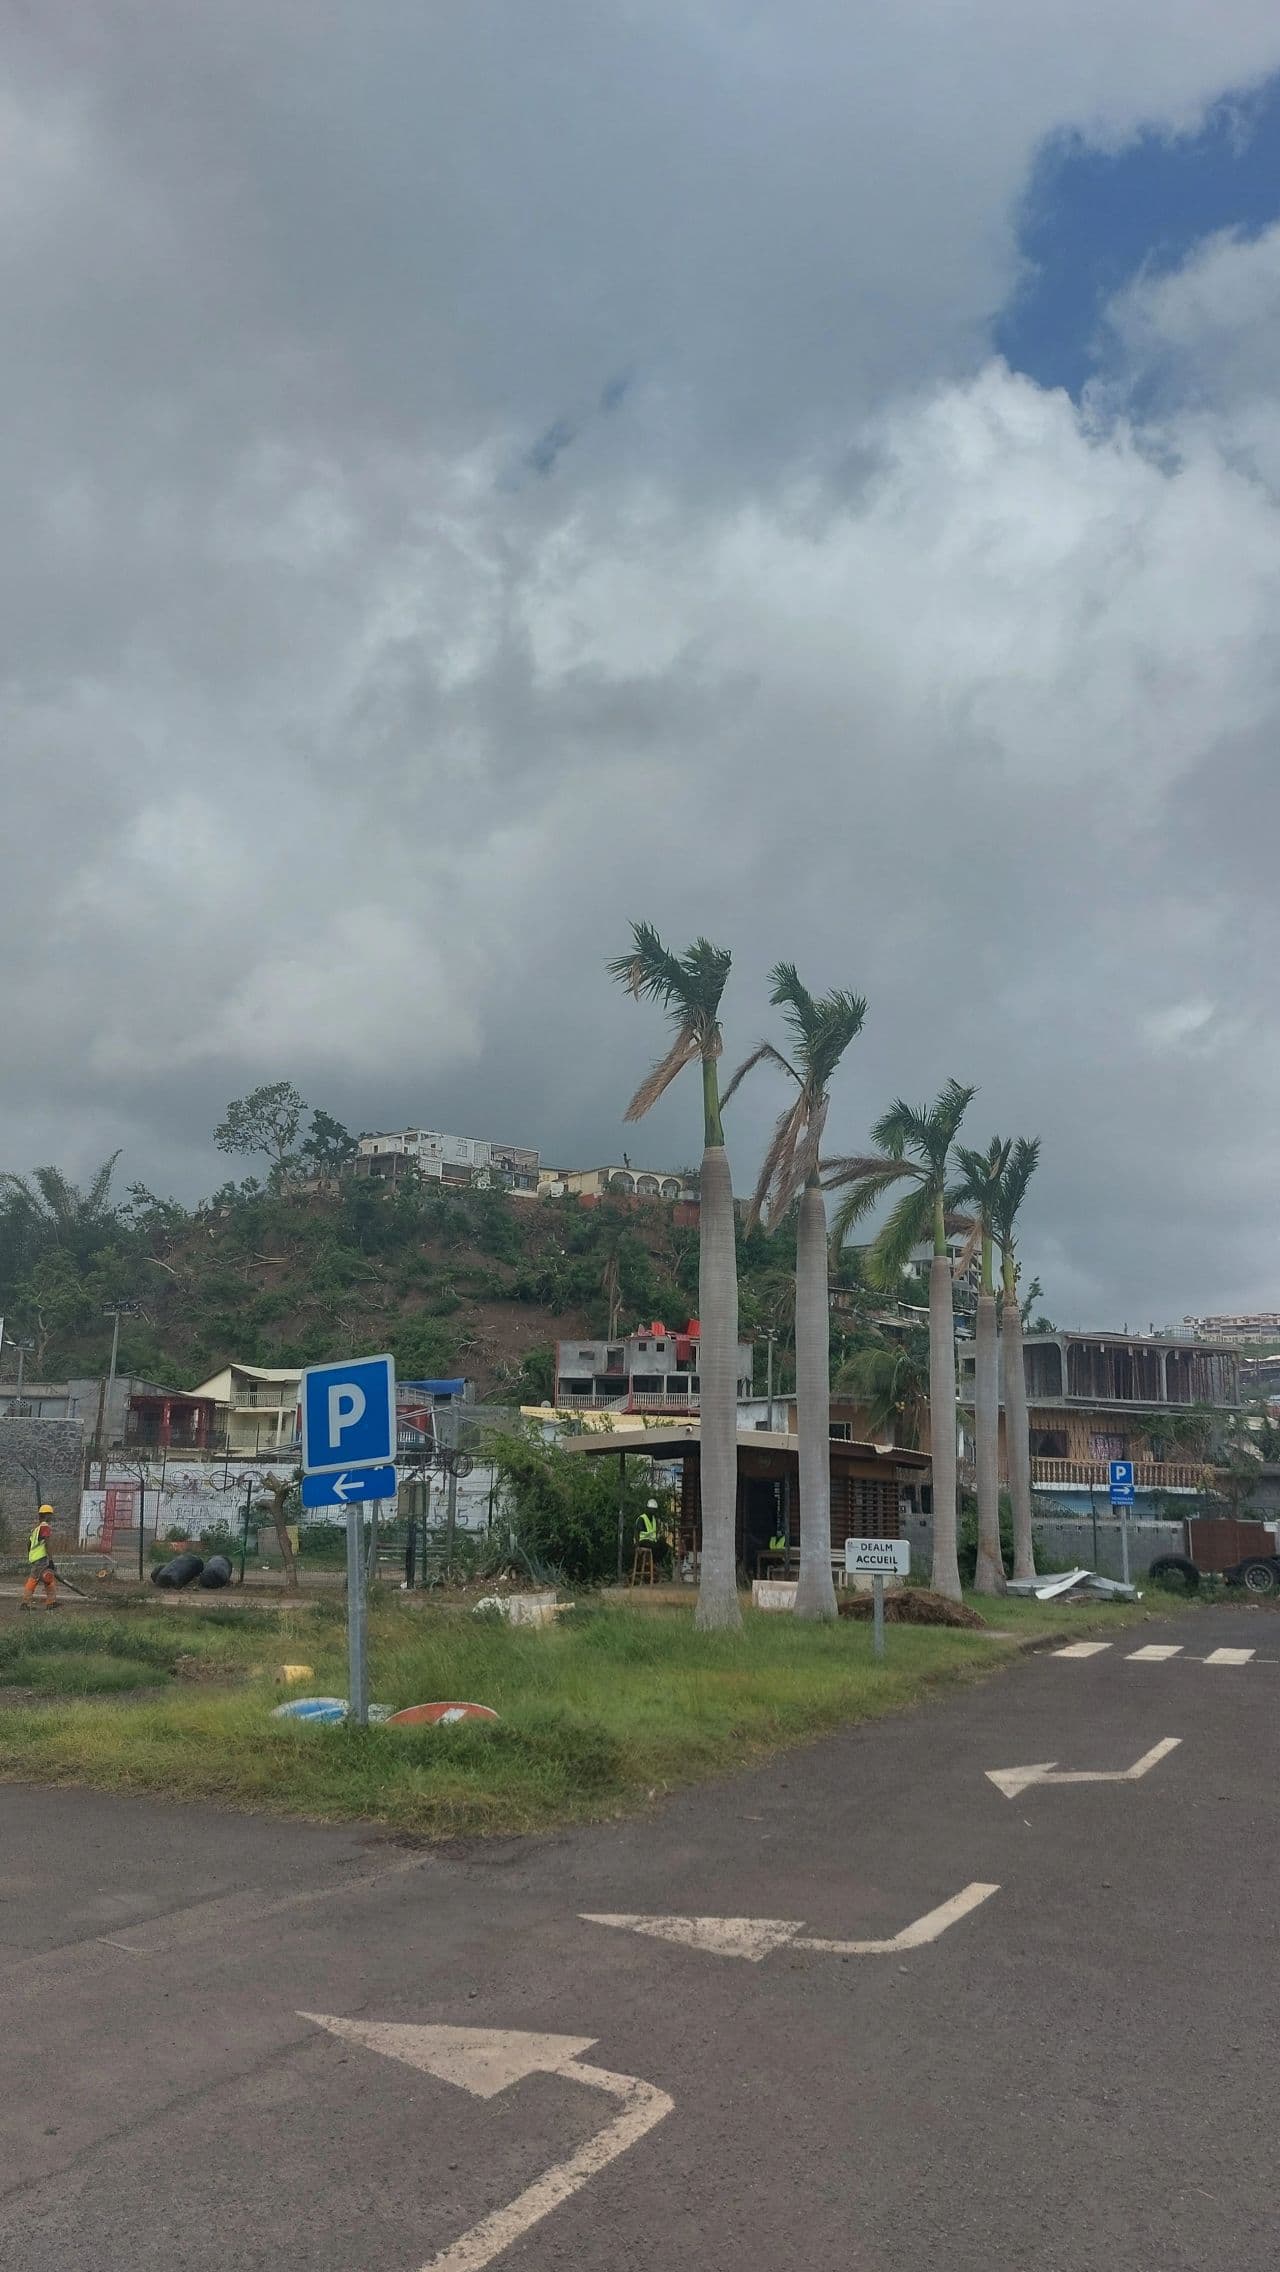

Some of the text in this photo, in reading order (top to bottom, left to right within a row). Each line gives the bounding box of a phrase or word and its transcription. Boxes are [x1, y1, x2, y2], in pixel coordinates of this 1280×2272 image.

[328, 1383, 366, 1448] P
[1116, 1465, 1127, 1480] P
[860, 1543, 893, 1552] DEALM
[856, 1555, 898, 1565] ACCUEIL
